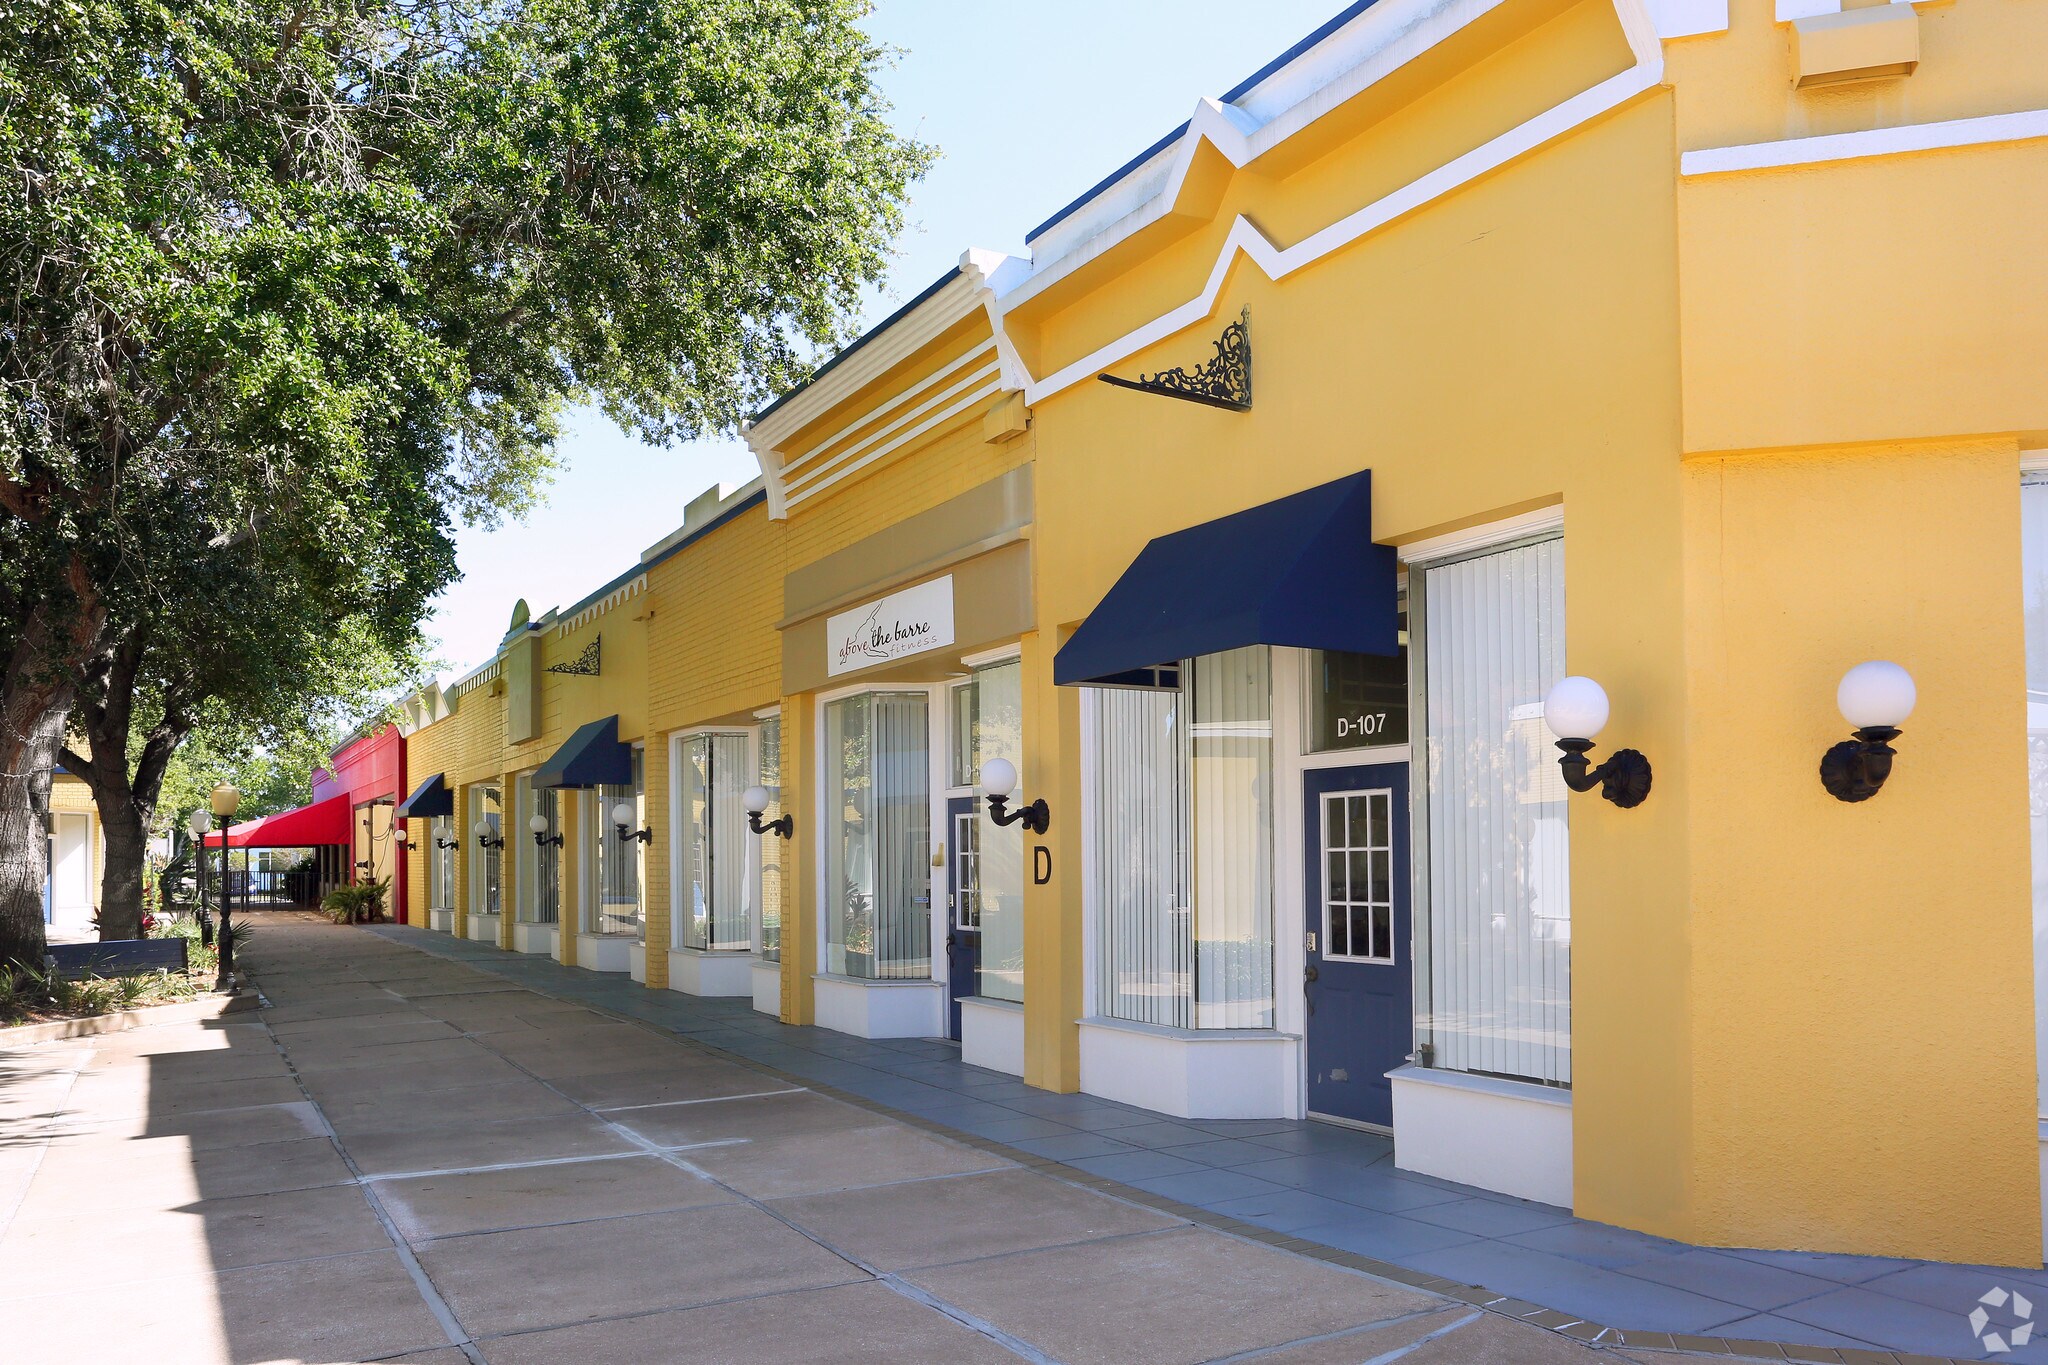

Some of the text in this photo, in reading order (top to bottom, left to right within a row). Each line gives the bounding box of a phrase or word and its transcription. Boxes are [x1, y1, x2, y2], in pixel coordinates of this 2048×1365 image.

[839, 620, 930, 657] above the barre
[889, 635, 938, 658] fitness
[1337, 713, 1386, 737] D-107
[1034, 846, 1052, 885] D
